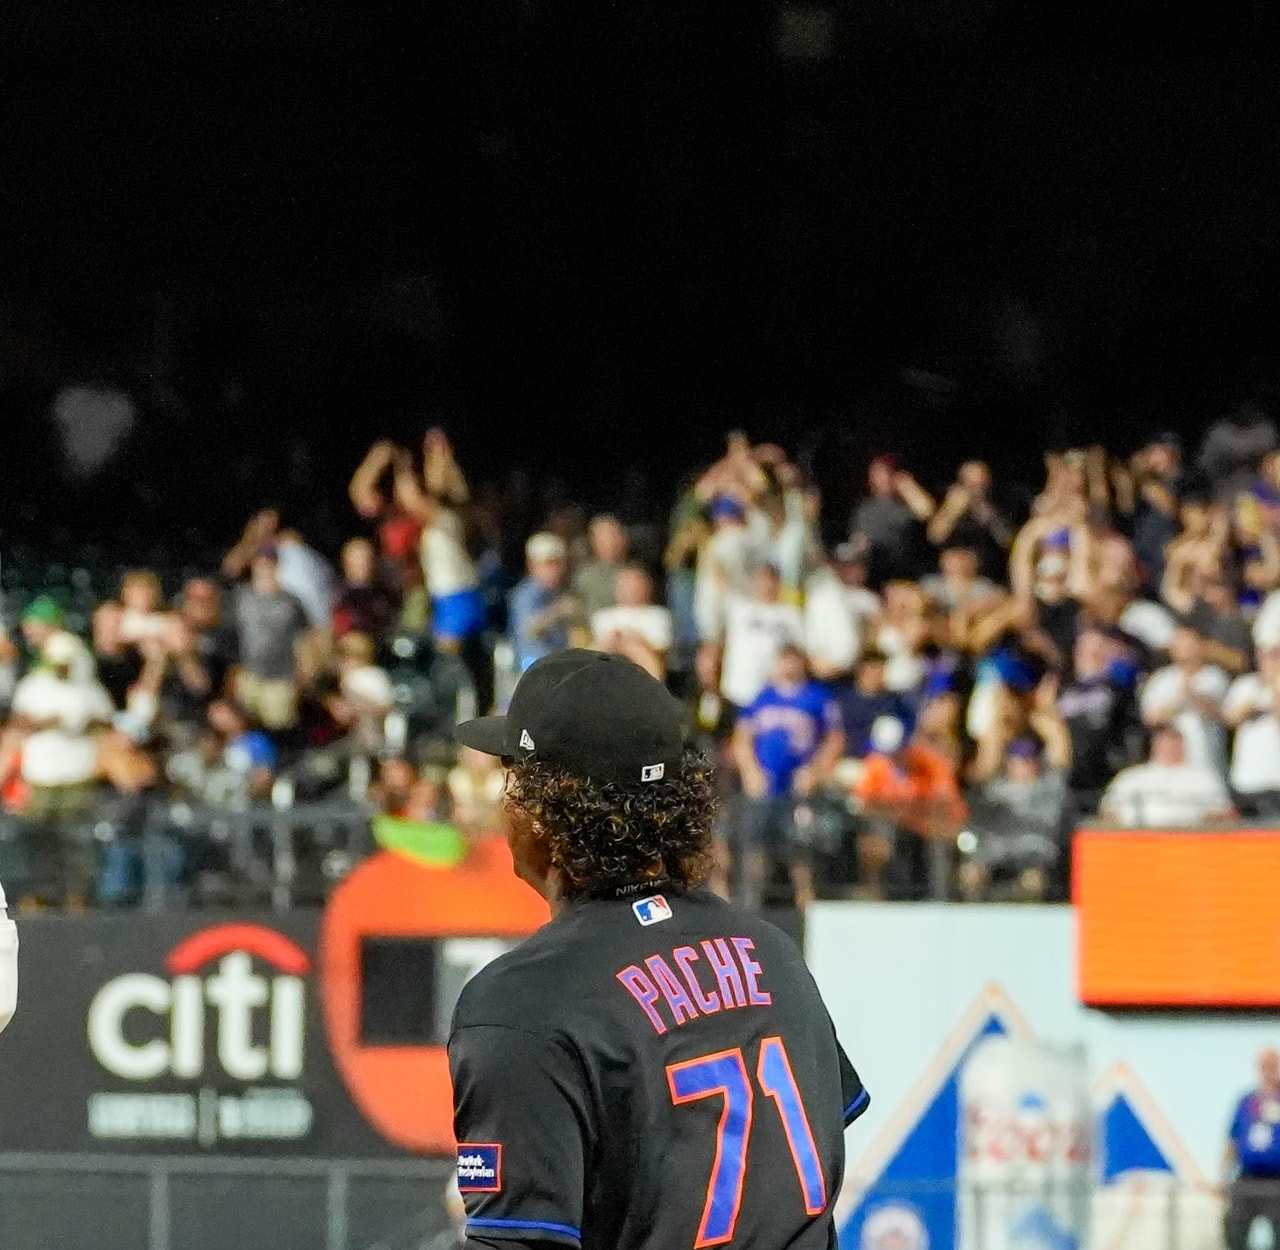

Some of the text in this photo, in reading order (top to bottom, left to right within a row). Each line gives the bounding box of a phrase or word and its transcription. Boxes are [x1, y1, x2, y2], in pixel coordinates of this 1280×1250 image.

[87, 949, 306, 1081] citi
[616, 936, 773, 1036] PACHE
[665, 1036, 828, 1250] 71
